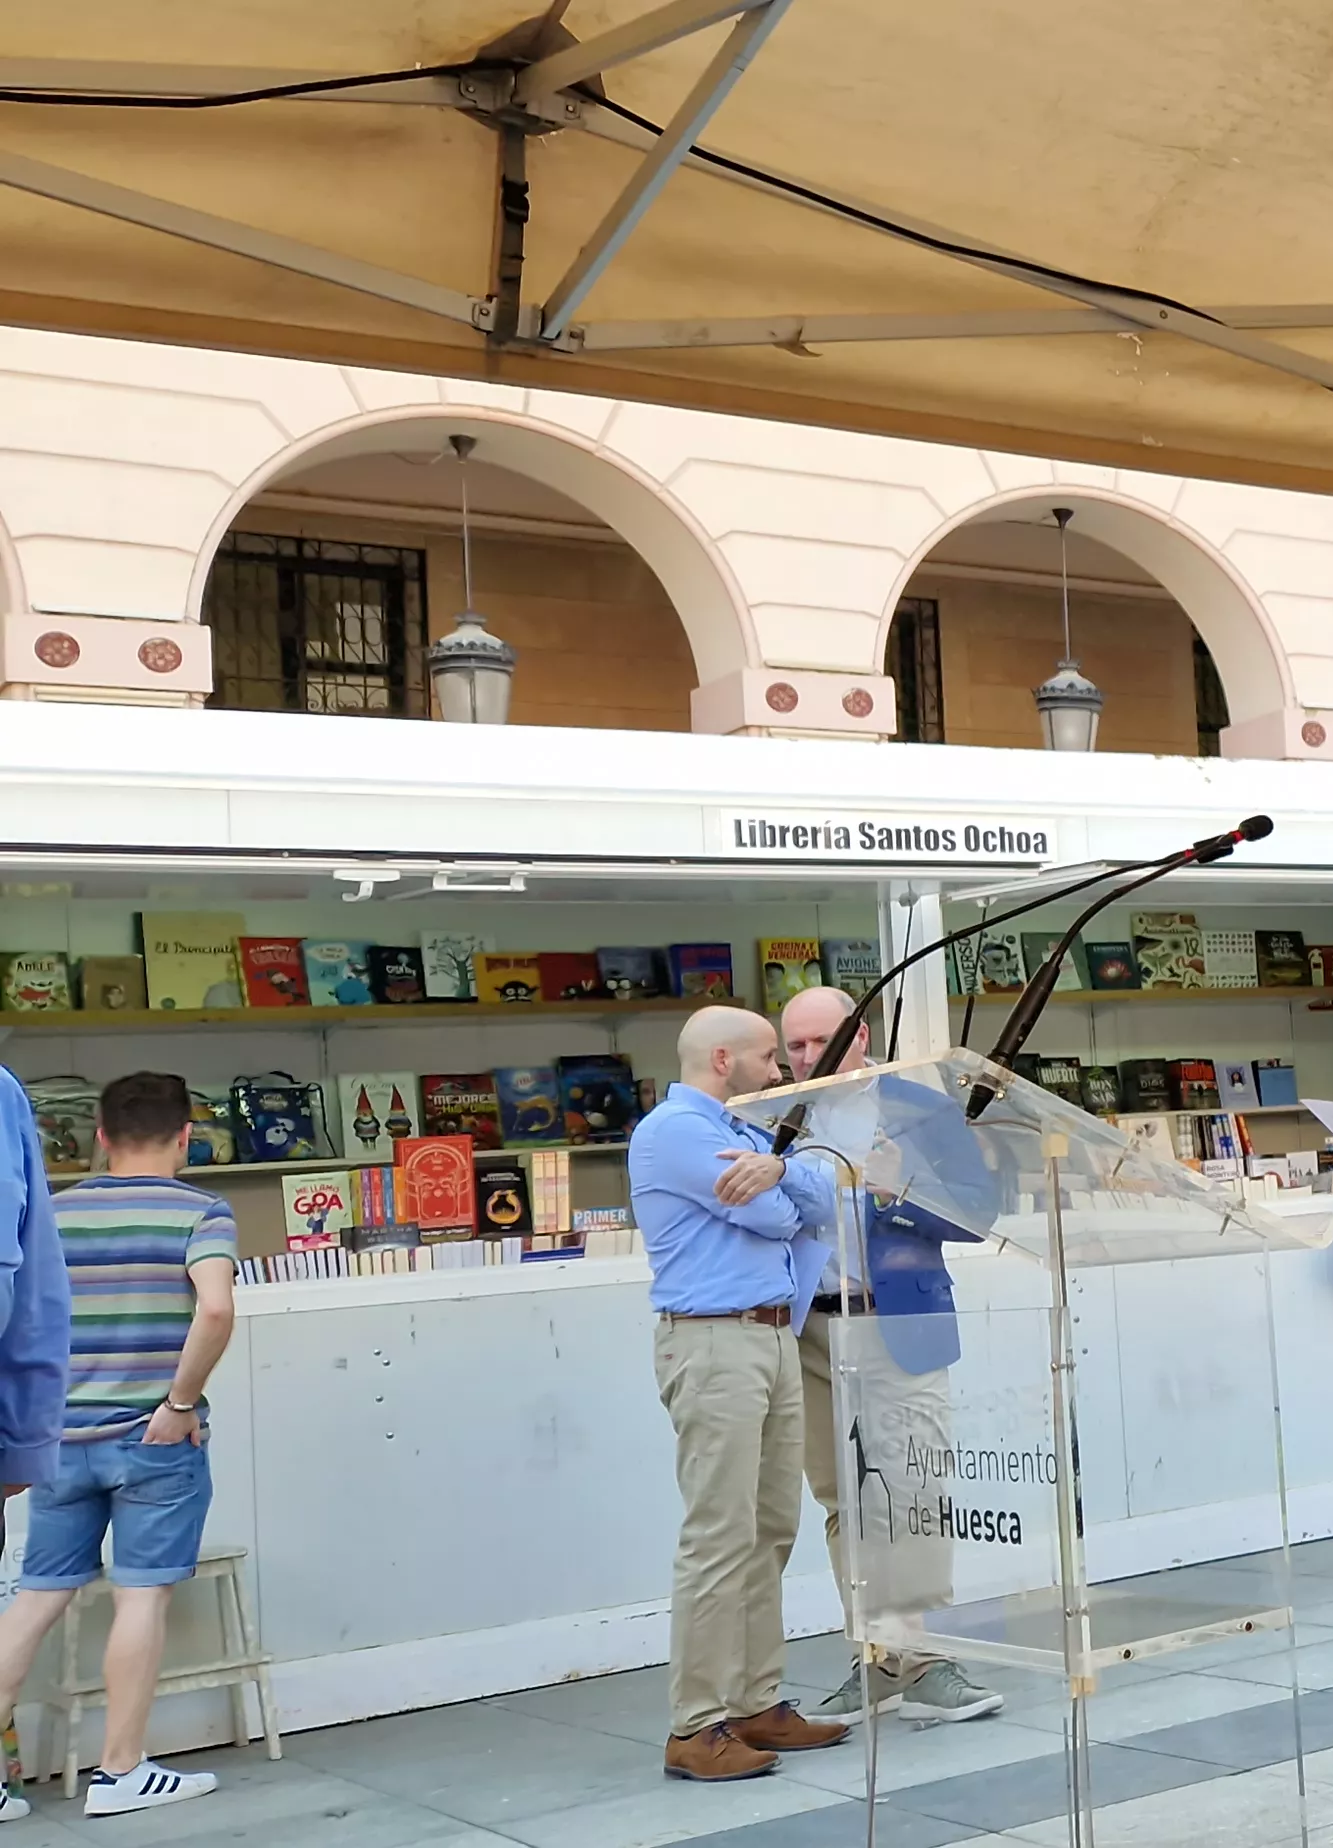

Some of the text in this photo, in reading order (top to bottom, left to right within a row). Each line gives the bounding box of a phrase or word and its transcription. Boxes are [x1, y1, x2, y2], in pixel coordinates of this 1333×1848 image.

[734, 818, 1048, 855] Librería Santos Ochoa
[837, 957, 881, 969] AVIONE
[293, 1192, 344, 1215] GOA
[573, 1209, 627, 1225] PRIMER
[906, 1435, 1060, 1490] Ayuntamiento
[908, 1494, 1022, 1545] de Huesca
